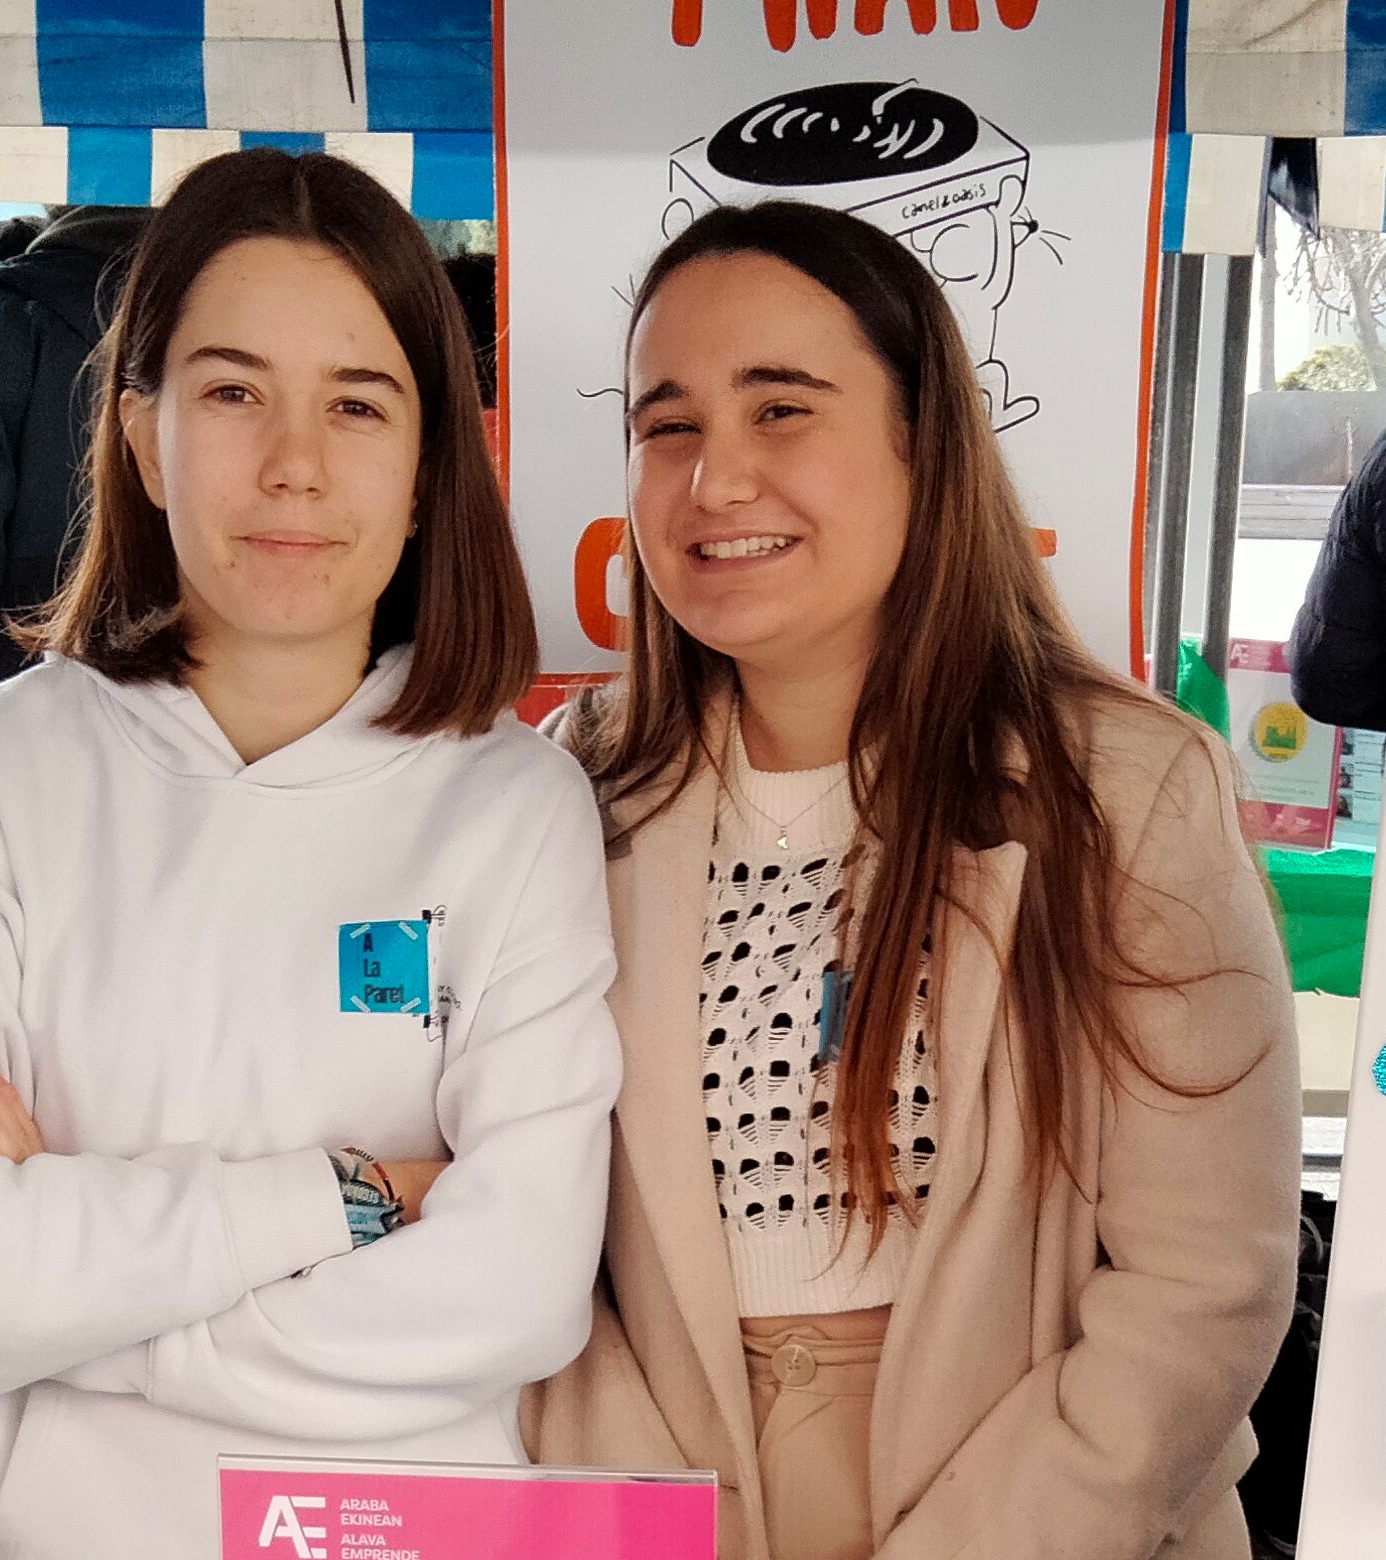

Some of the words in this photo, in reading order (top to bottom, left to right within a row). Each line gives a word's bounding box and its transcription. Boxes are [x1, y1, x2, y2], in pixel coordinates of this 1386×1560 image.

[363, 933, 374, 953] A
[340, 1499, 390, 1512] ARABA
[341, 1513, 403, 1527] EKINEAN
